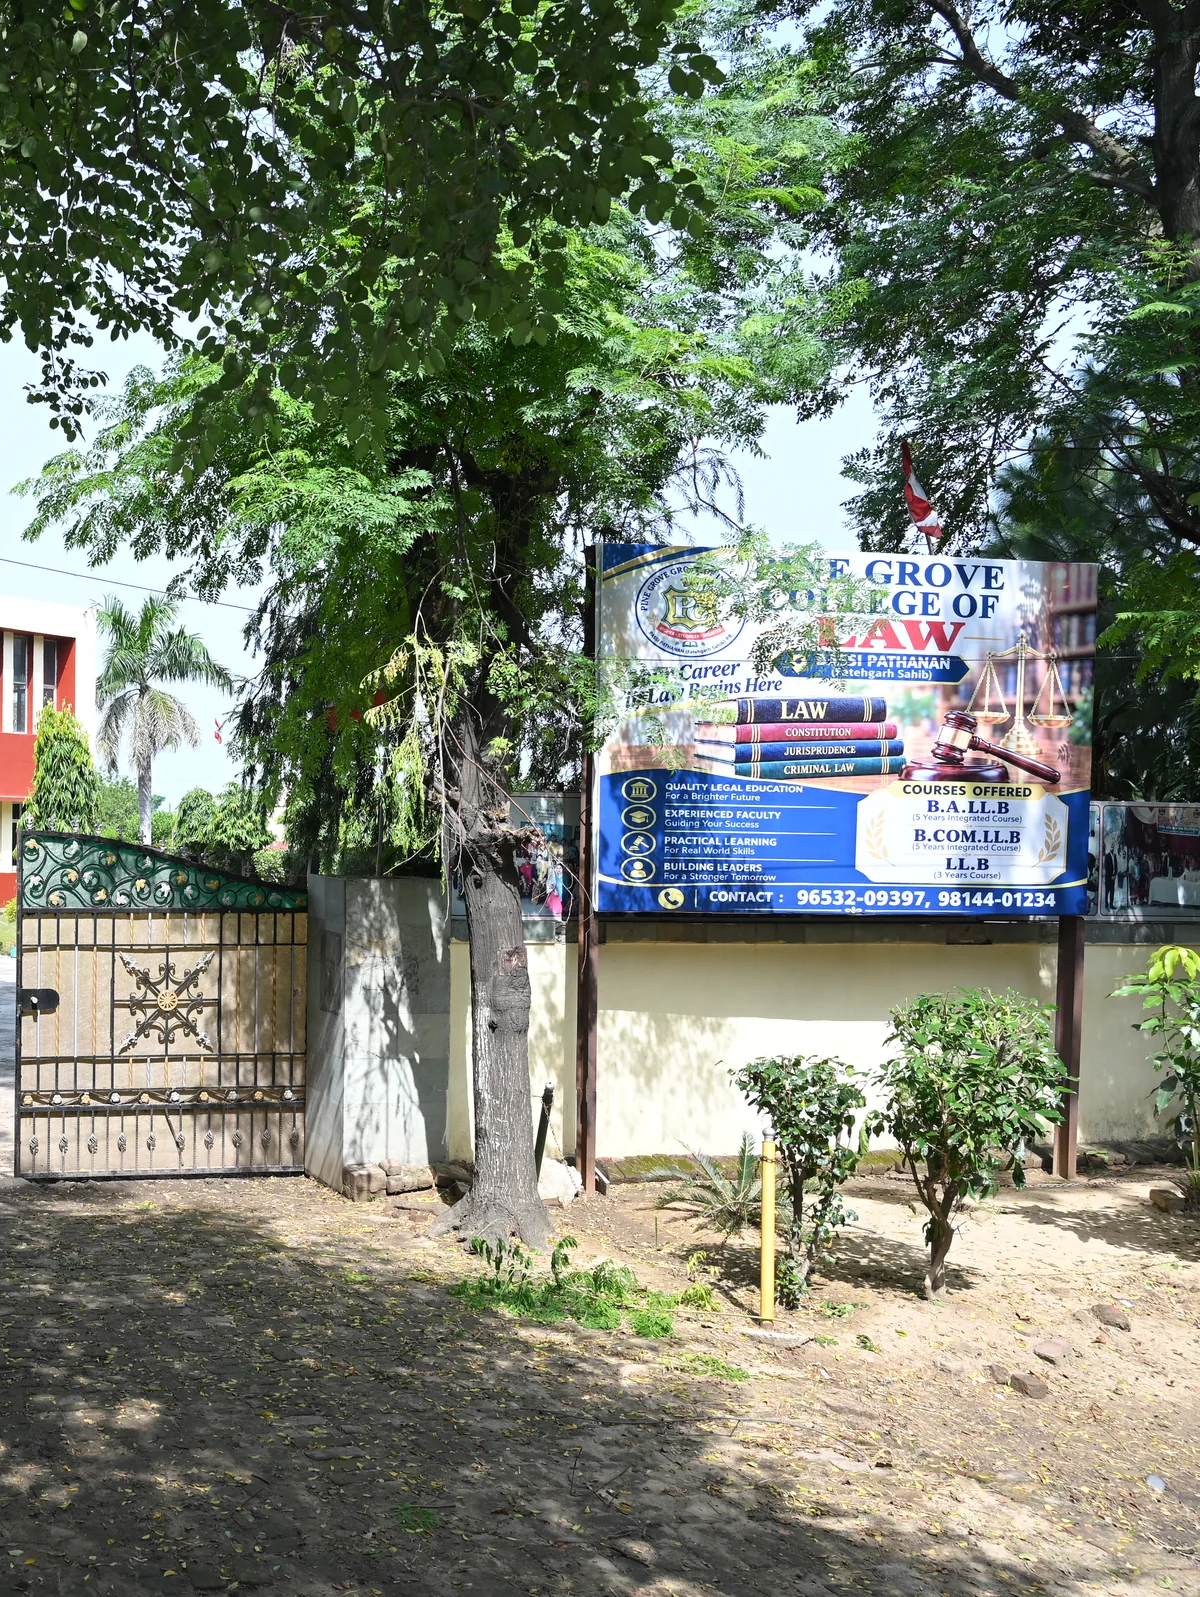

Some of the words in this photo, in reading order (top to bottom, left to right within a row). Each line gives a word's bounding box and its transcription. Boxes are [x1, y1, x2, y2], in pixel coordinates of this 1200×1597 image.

[865, 559, 1005, 590] GROVE
[641, 591, 651, 611] PINE
[647, 571, 670, 592] GROVE
[952, 593, 1000, 619] OF
[815, 616, 966, 652] LAW
[867, 654, 950, 670] PATHANAN
[679, 662, 741, 681] Career
[897, 669, 933, 681] Sahib)
[745, 677, 783, 693] Here
[780, 700, 829, 720] LAW
[785, 727, 852, 737] CONSTITUTION
[784, 745, 857, 756] JURISPRUDENCE
[783, 764, 831, 775] CRIMINAL
[834, 763, 856, 773] LAW
[665, 783, 708, 791] QUALITY
[711, 784, 743, 792] LEGAL
[745, 785, 804, 793] EDUCATION
[903, 784, 967, 796] COURSES
[972, 786, 1032, 797] OFFERED
[665, 792, 681, 800] For
[691, 793, 729, 802] Brighter
[731, 793, 761, 801] Future
[927, 800, 1010, 814] B.A.LL.B
[664, 810, 734, 819] EXPERIENCED
[736, 811, 782, 820] FACULTY
[912, 813, 921, 822] (5
[923, 814, 946, 822] Years
[947, 815, 990, 824] Integrated
[992, 815, 1023, 824] Course)
[664, 820, 700, 828] Guiding
[702, 820, 723, 828] Your
[725, 820, 760, 828] Success
[664, 837, 722, 845] PRACTICAL
[724, 837, 778, 846] LEARNING
[914, 829, 1021, 844] B.COM.LL.B
[664, 846, 680, 854] For
[681, 846, 701, 854] Real
[703, 847, 731, 855] World
[732, 847, 756, 855] Skills
[912, 844, 921, 852] (5
[947, 844, 989, 852] Integrated
[991, 844, 1022, 853] Course)
[664, 863, 714, 871] BUILDING
[717, 863, 763, 872] LEADERS
[945, 857, 990, 871] LL.B
[664, 872, 680, 880] For
[689, 872, 729, 882] Stronger
[731, 873, 777, 881] Tomorrow
[933, 871, 942, 880] (3
[944, 871, 968, 879] Years
[969, 871, 1002, 880] Course)
[709, 891, 774, 902] CONTACT
[797, 889, 931, 909] 96532-09397,
[938, 890, 1056, 908] 98144-01234
